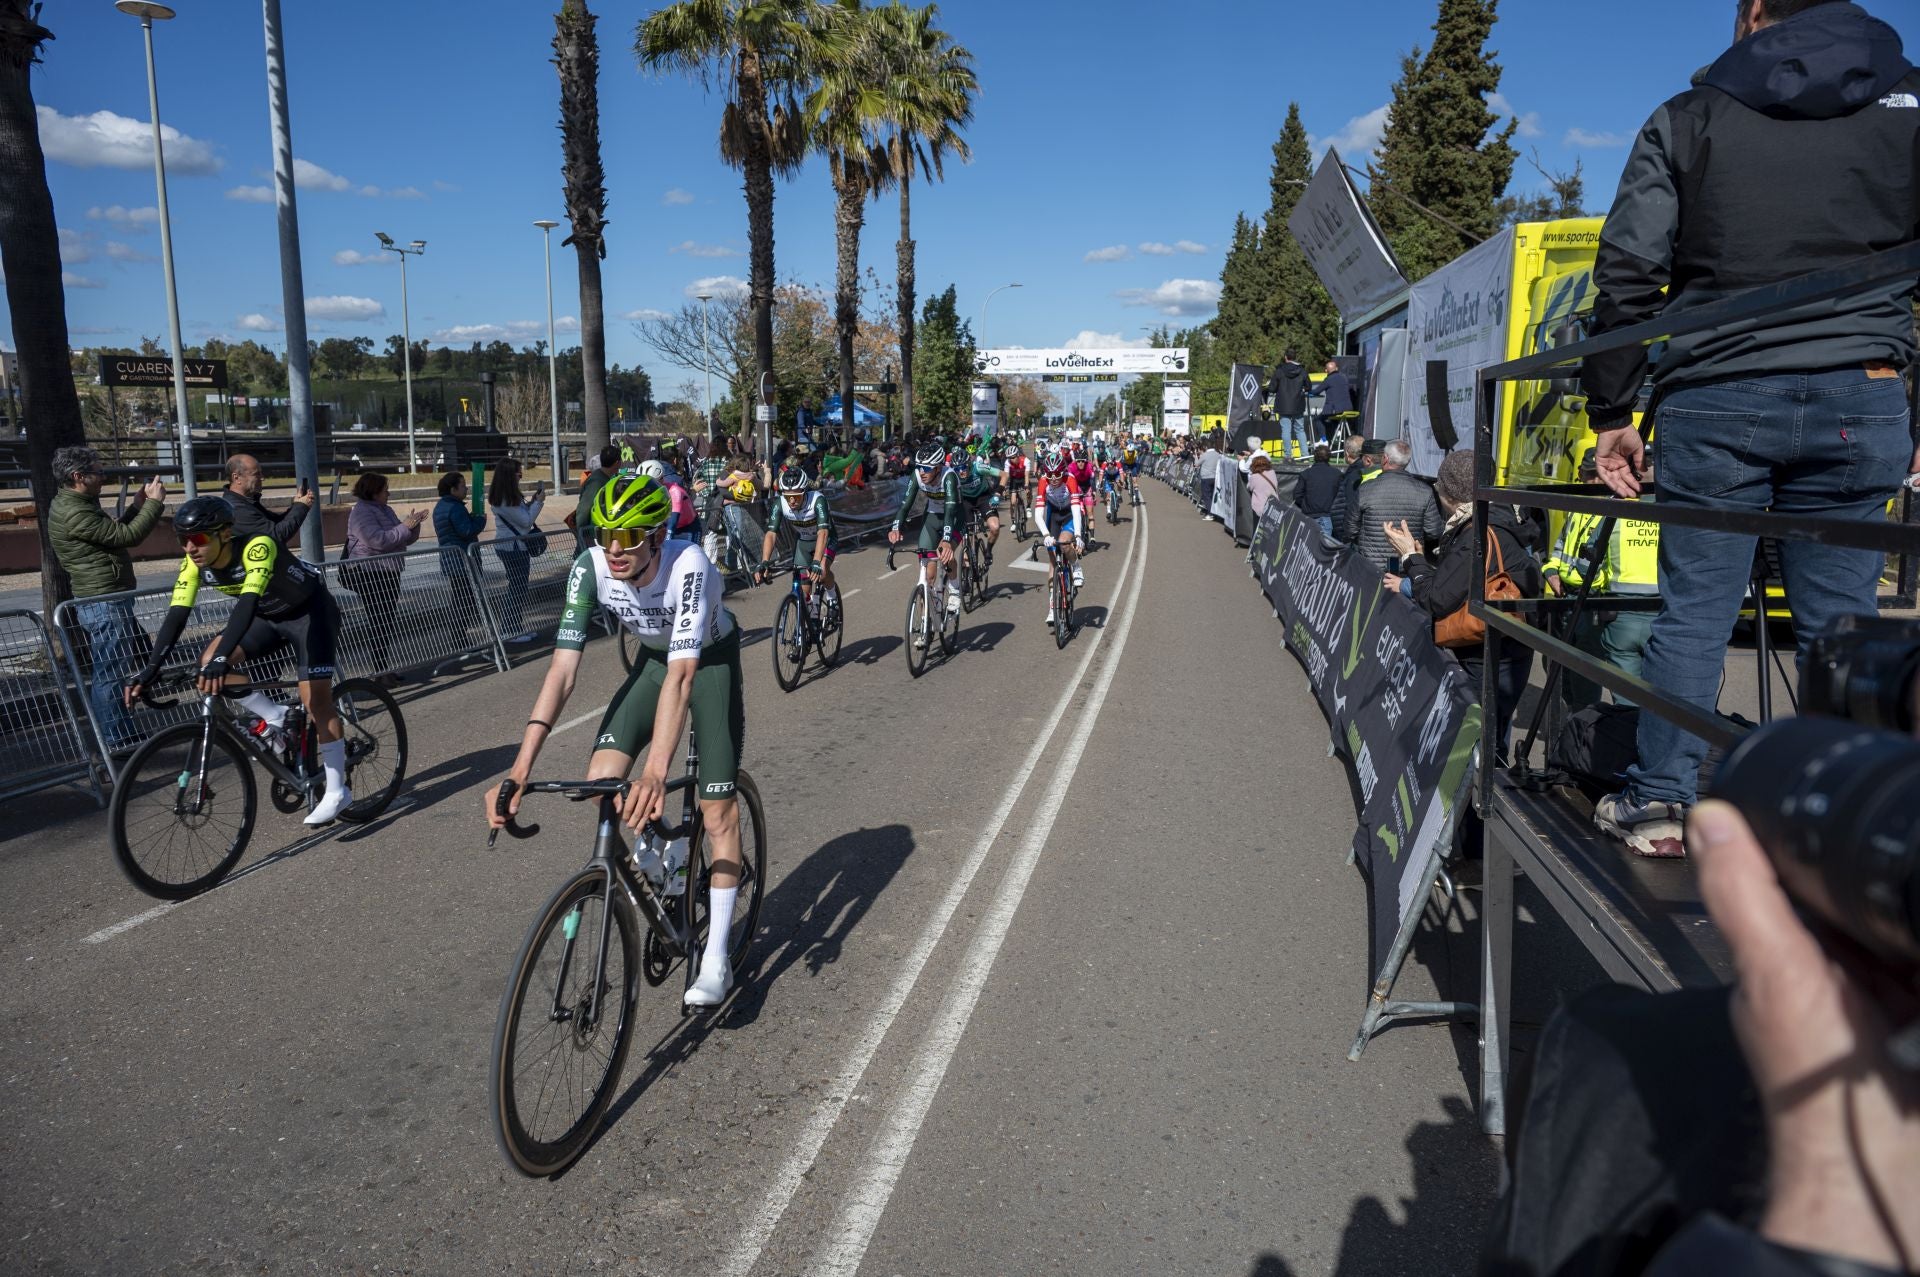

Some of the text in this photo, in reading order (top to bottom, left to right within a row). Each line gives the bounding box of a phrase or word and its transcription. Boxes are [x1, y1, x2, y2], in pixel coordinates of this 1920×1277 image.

[1424, 291, 1480, 343] LaVueltaExt
[116, 361, 215, 376] CUARENA Y 7
[1046, 356, 1114, 367] LaVueltaExt
[569, 566, 587, 605] RGA
[681, 572, 695, 616] RGA
[691, 571, 704, 614] SEGUROS
[1281, 520, 1354, 655] Extremadura
[1376, 624, 1417, 703] eurace
[1381, 686, 1402, 731] SPORT
[706, 781, 735, 793] GEXA
